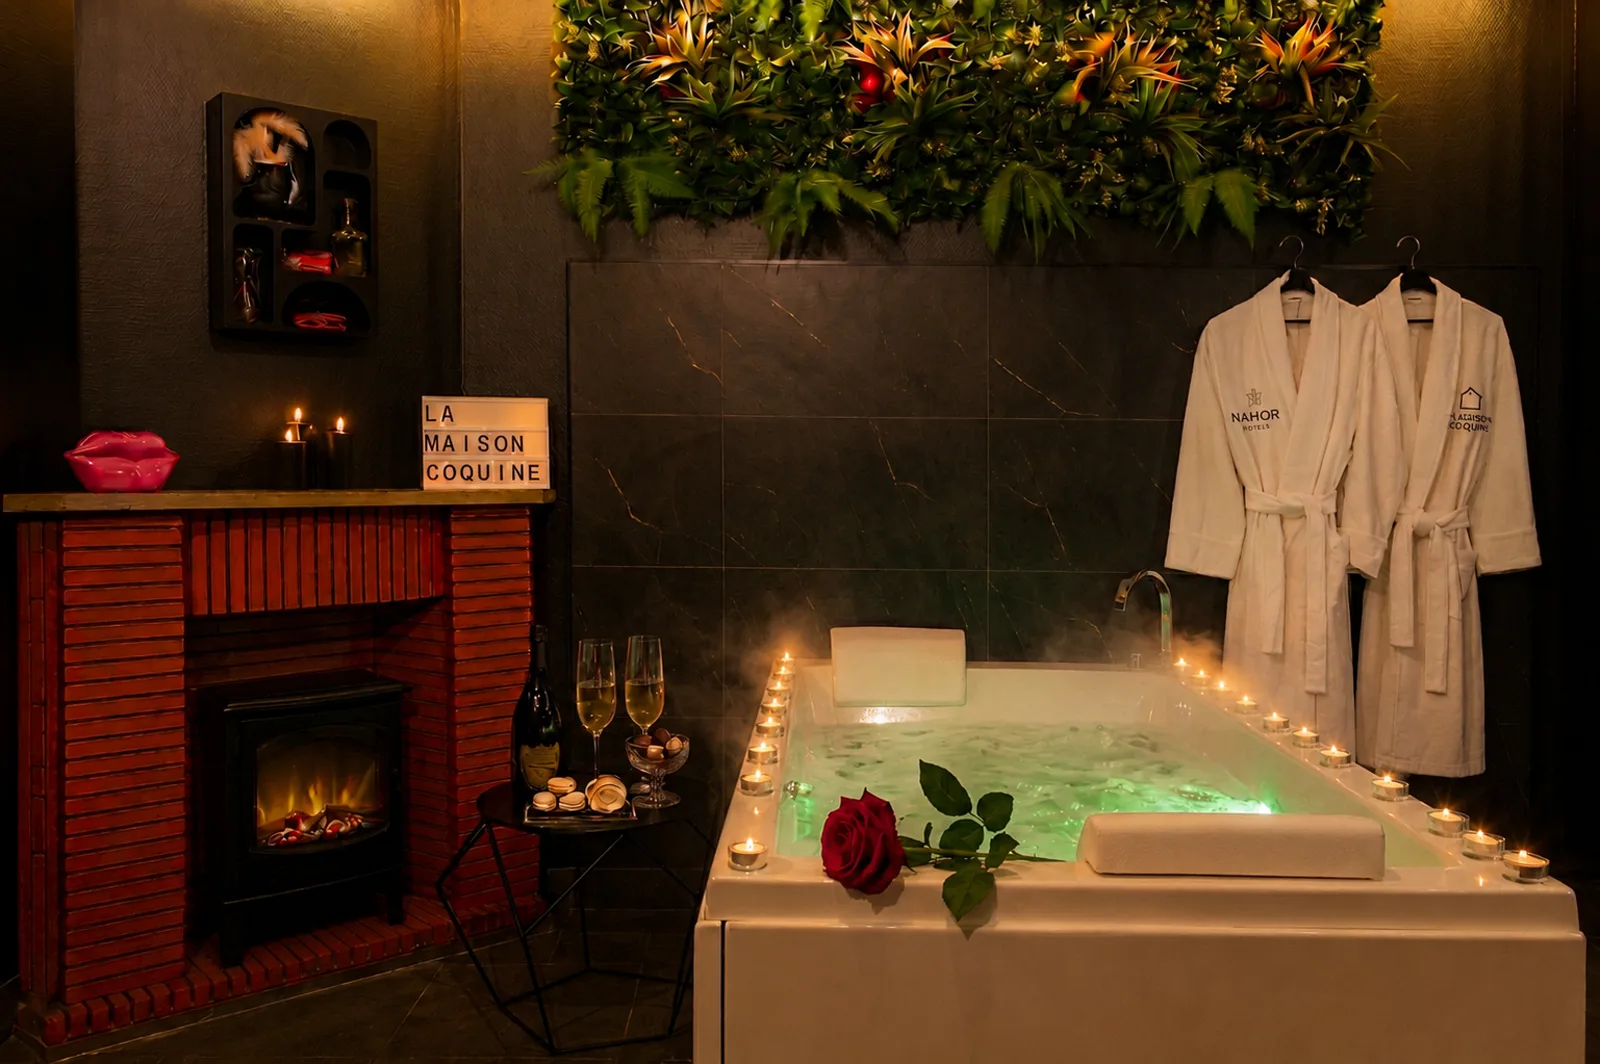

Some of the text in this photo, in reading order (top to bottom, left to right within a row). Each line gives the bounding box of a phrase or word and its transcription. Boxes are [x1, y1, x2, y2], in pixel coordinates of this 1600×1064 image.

[425, 404, 454, 422] LA
[1231, 409, 1280, 423] NAHOR
[1242, 423, 1270, 432] HOTELS
[425, 434, 524, 453] MAISON
[426, 464, 540, 482] COQUINE
